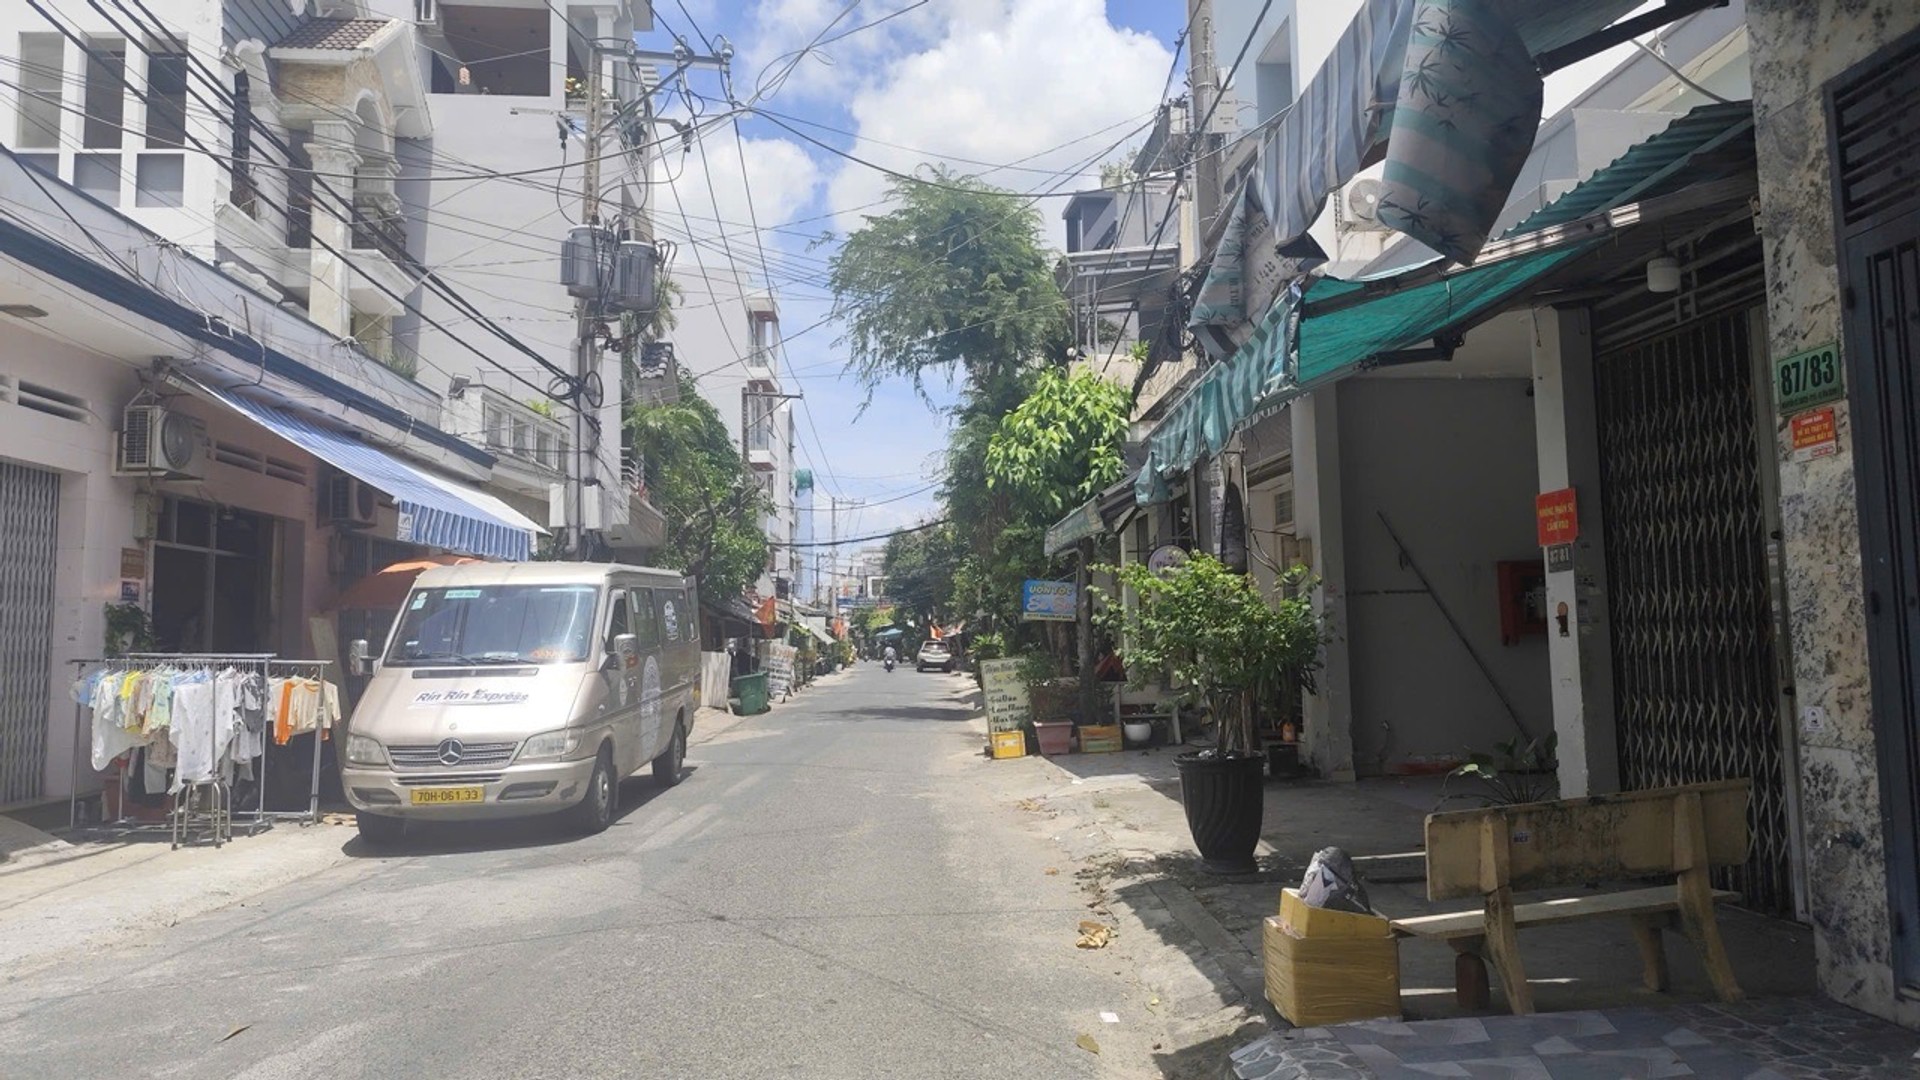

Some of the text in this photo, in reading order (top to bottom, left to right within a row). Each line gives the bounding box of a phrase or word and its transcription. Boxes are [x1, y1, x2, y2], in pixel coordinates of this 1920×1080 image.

[1780, 351, 1835, 397] 87/83
[415, 688, 529, 702] Rin Rin Express
[417, 790, 479, 802] 70H-061.33
